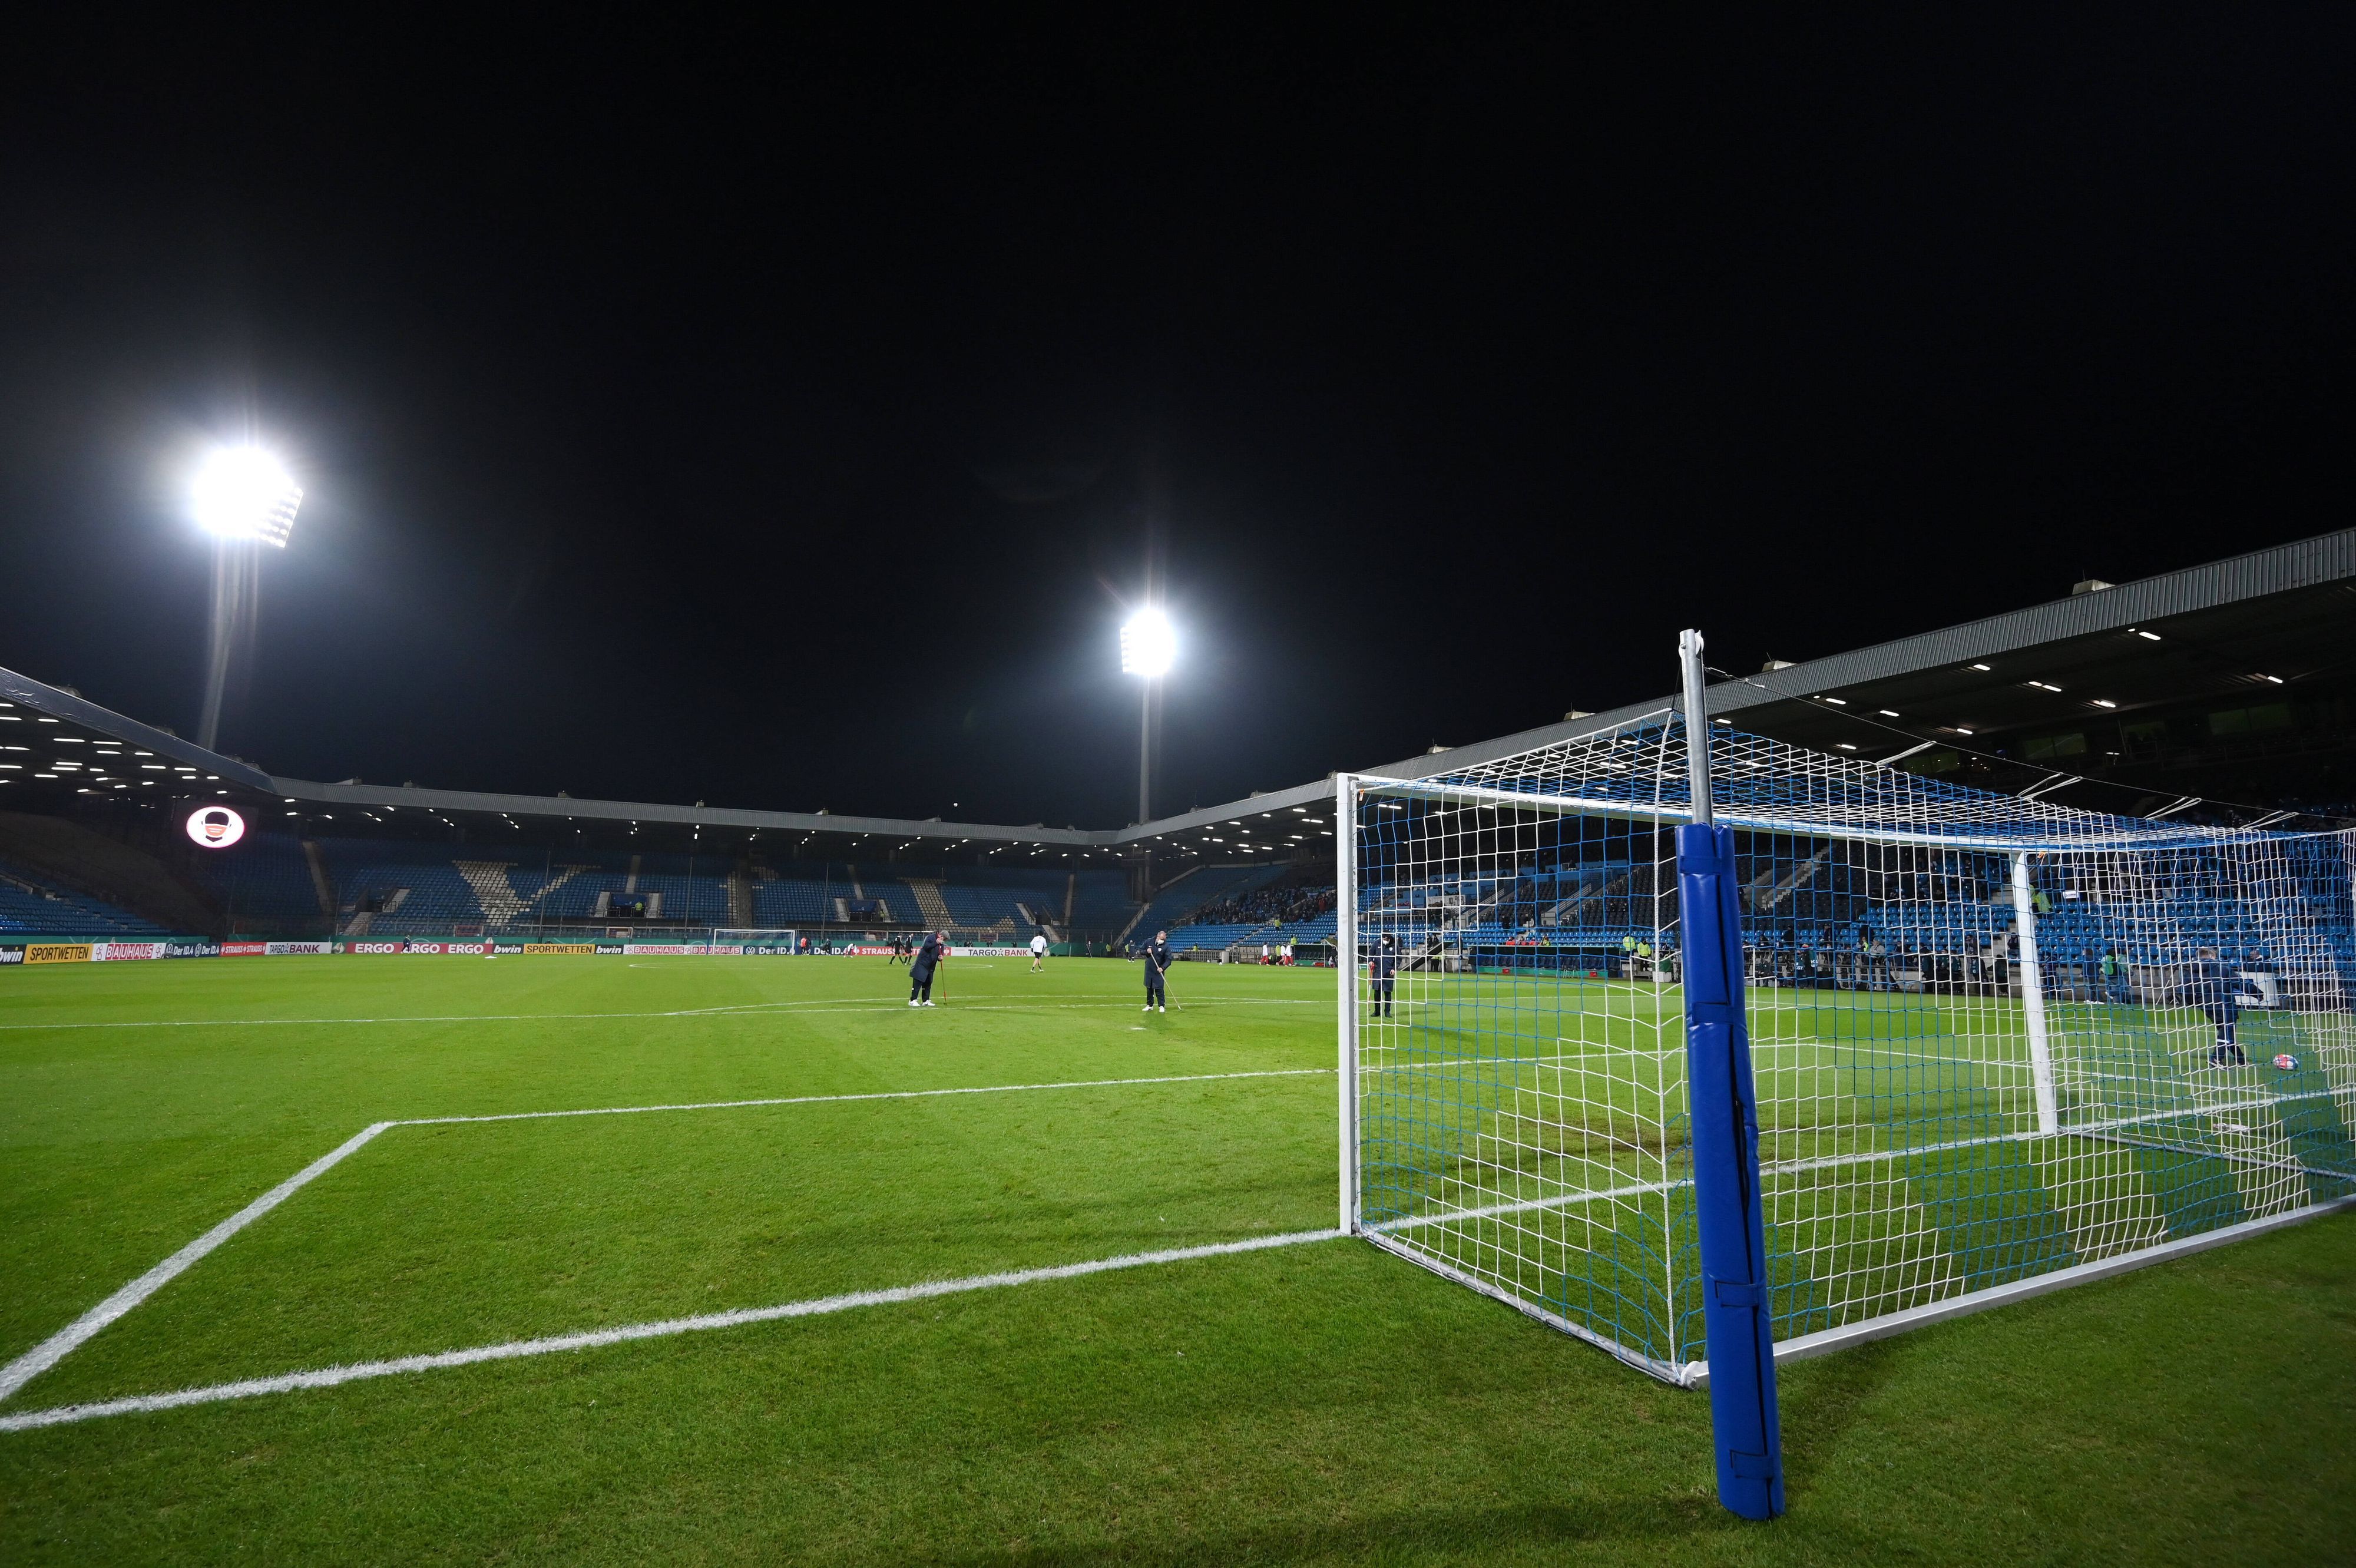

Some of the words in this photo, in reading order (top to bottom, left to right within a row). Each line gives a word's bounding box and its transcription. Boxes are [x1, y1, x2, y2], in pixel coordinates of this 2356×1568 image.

[105, 944, 154, 960] BAUHAUS
[174, 946, 183, 955] Der
[183, 945, 194, 955] ID.4
[201, 946, 210, 954] Der
[210, 945, 220, 954] ID.4
[355, 943, 394, 953] ERGO
[448, 944, 484, 954] ERGO
[494, 945, 521, 954] bwin
[527, 945, 593, 954] SPORTWETTEN
[595, 945, 622, 954] bwin
[693, 946, 741, 954] BAUHAUS
[759, 947, 776, 955] Der
[30, 947, 89, 961] SPORTWETTEN
